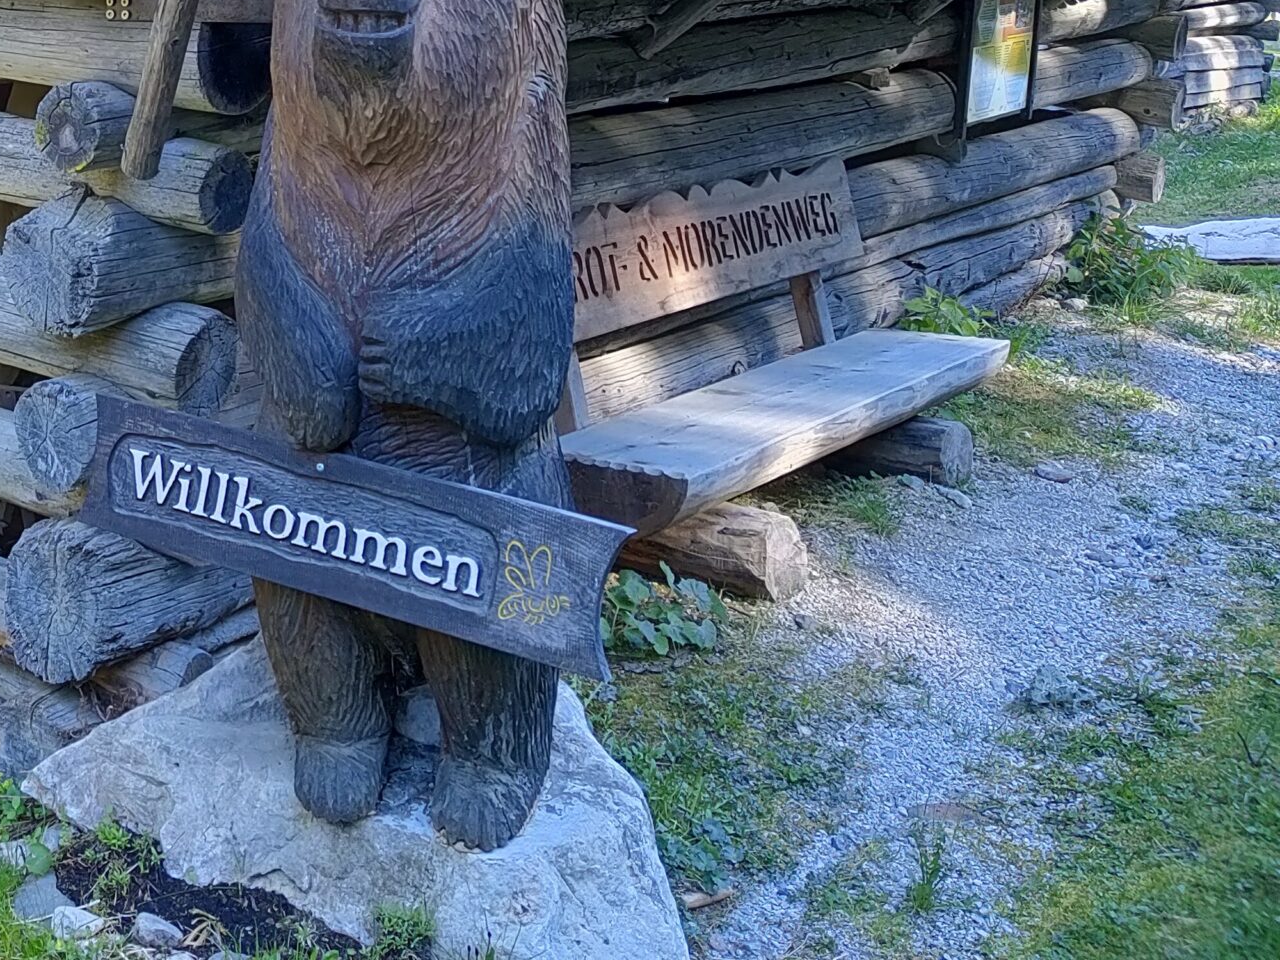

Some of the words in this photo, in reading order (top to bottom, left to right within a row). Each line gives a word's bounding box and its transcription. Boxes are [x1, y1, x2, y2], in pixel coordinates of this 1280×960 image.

[573, 242, 628, 303] ROT-
[637, 235, 659, 281] &
[663, 192, 838, 278] MORENDENWEG
[129, 449, 483, 597] Willkommen
